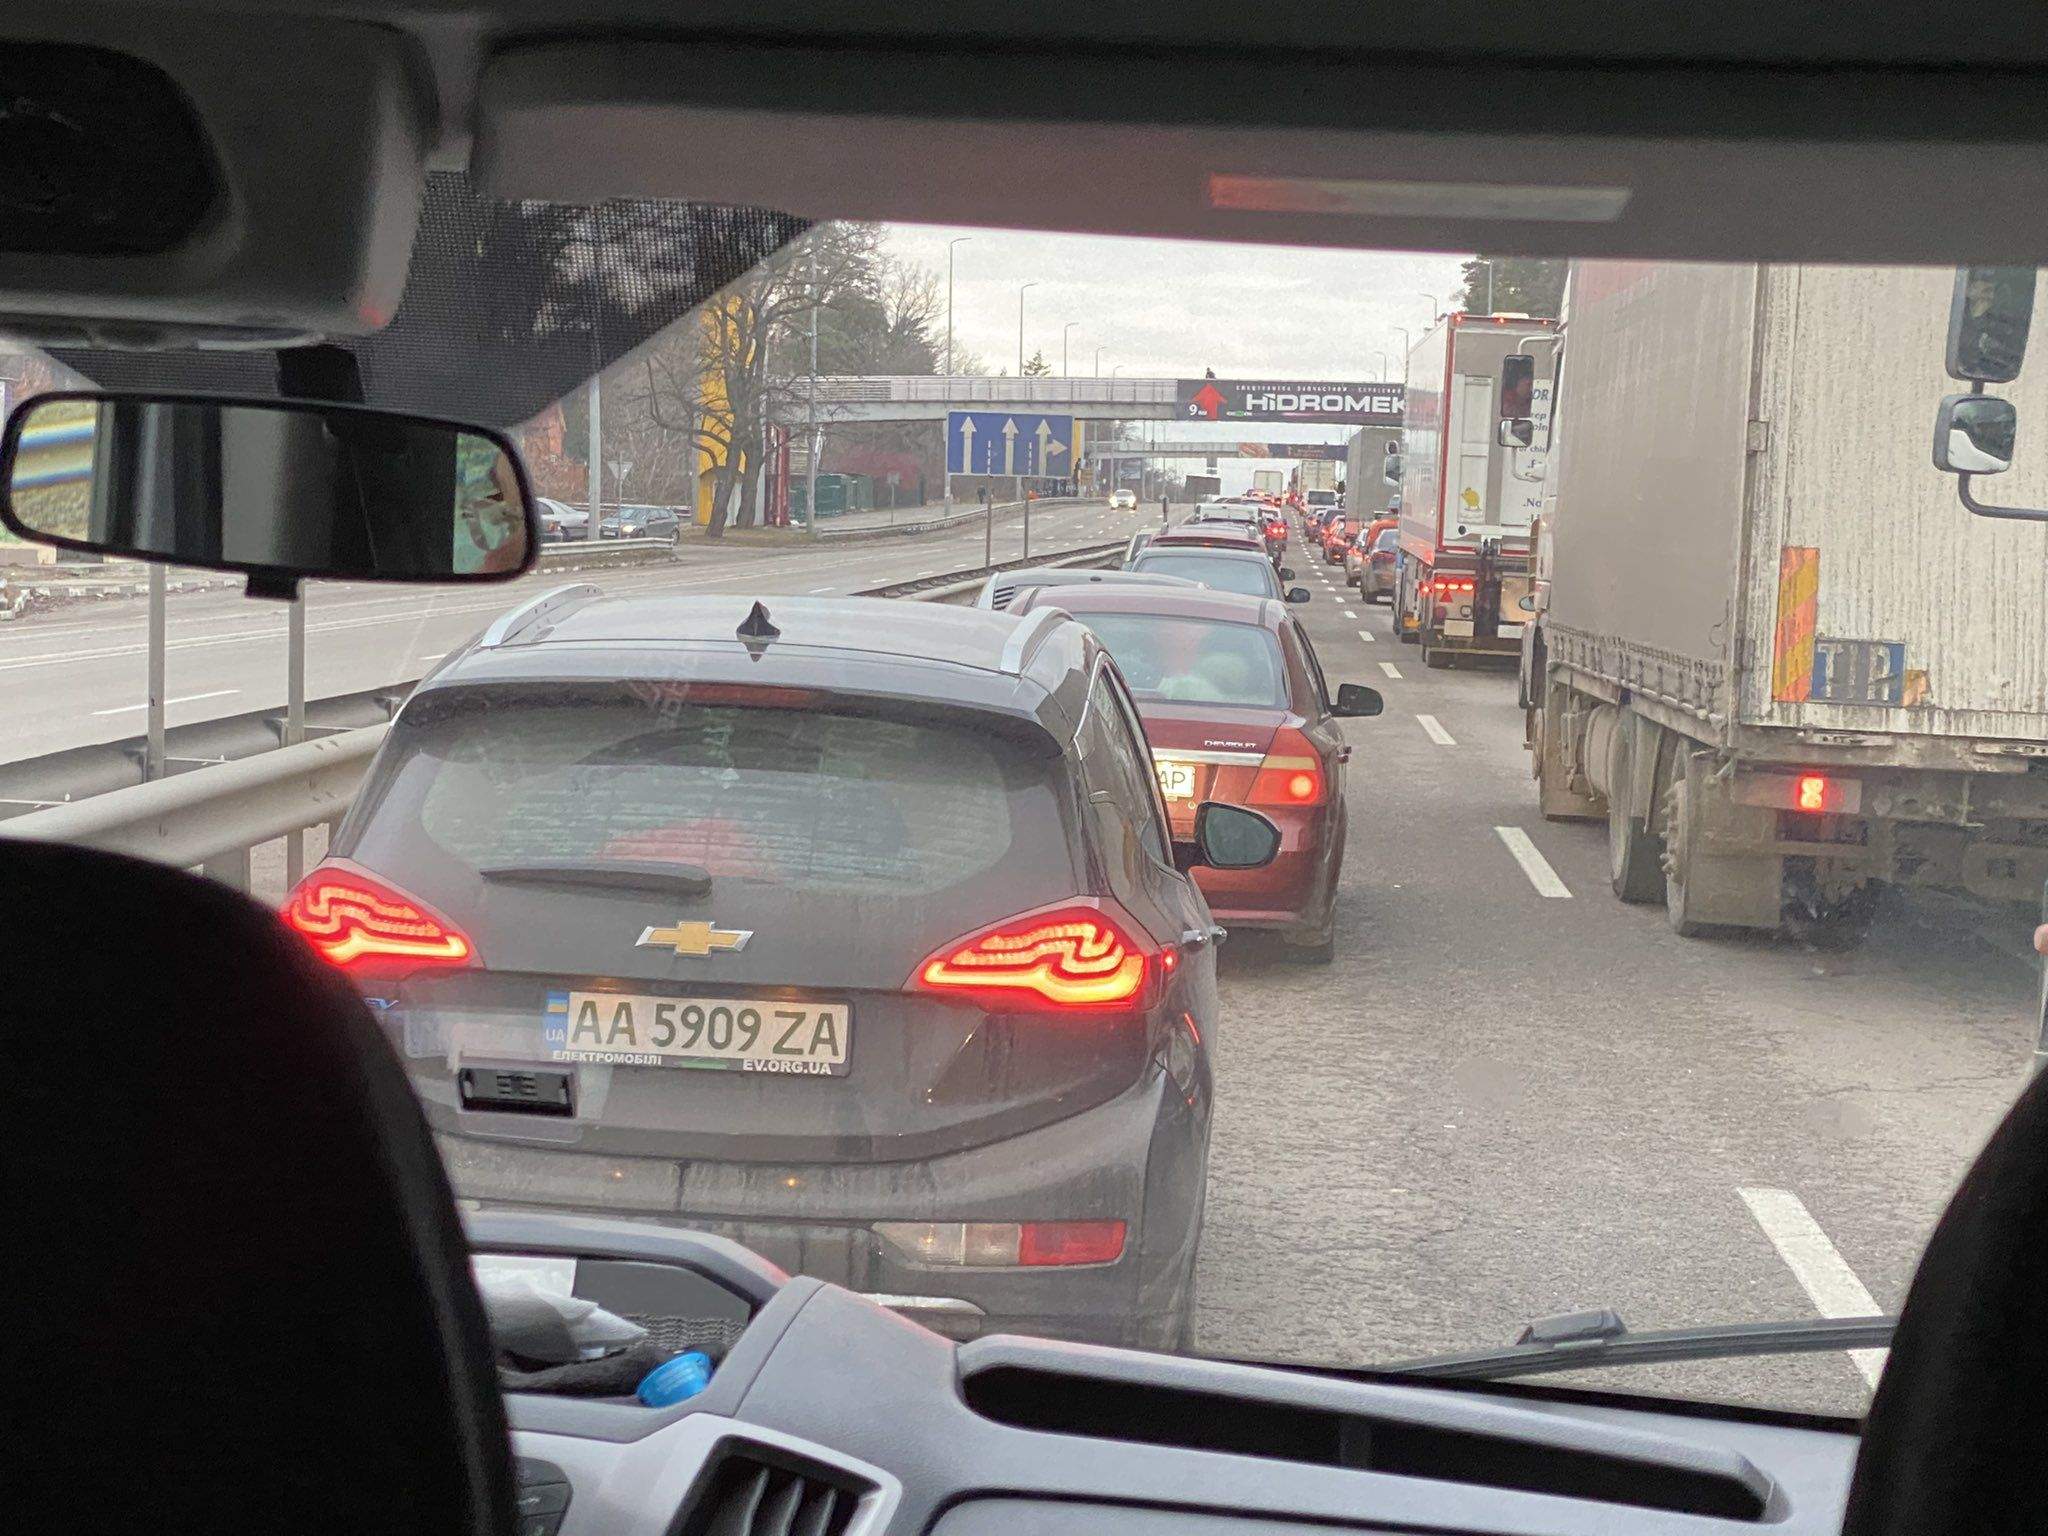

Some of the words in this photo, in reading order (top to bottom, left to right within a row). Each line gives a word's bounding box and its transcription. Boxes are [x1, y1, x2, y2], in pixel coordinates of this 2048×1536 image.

[1189, 404, 1198, 416] 9
[1816, 643, 1891, 701] TIR
[545, 1028, 566, 1043] UA
[571, 999, 637, 1046] AA
[651, 1002, 762, 1052] 5909
[771, 1010, 840, 1057] ZA
[552, 1049, 662, 1066] ЕЛЕКТРОМОБІЛІ
[741, 1058, 833, 1076] EV.ORG.UA
